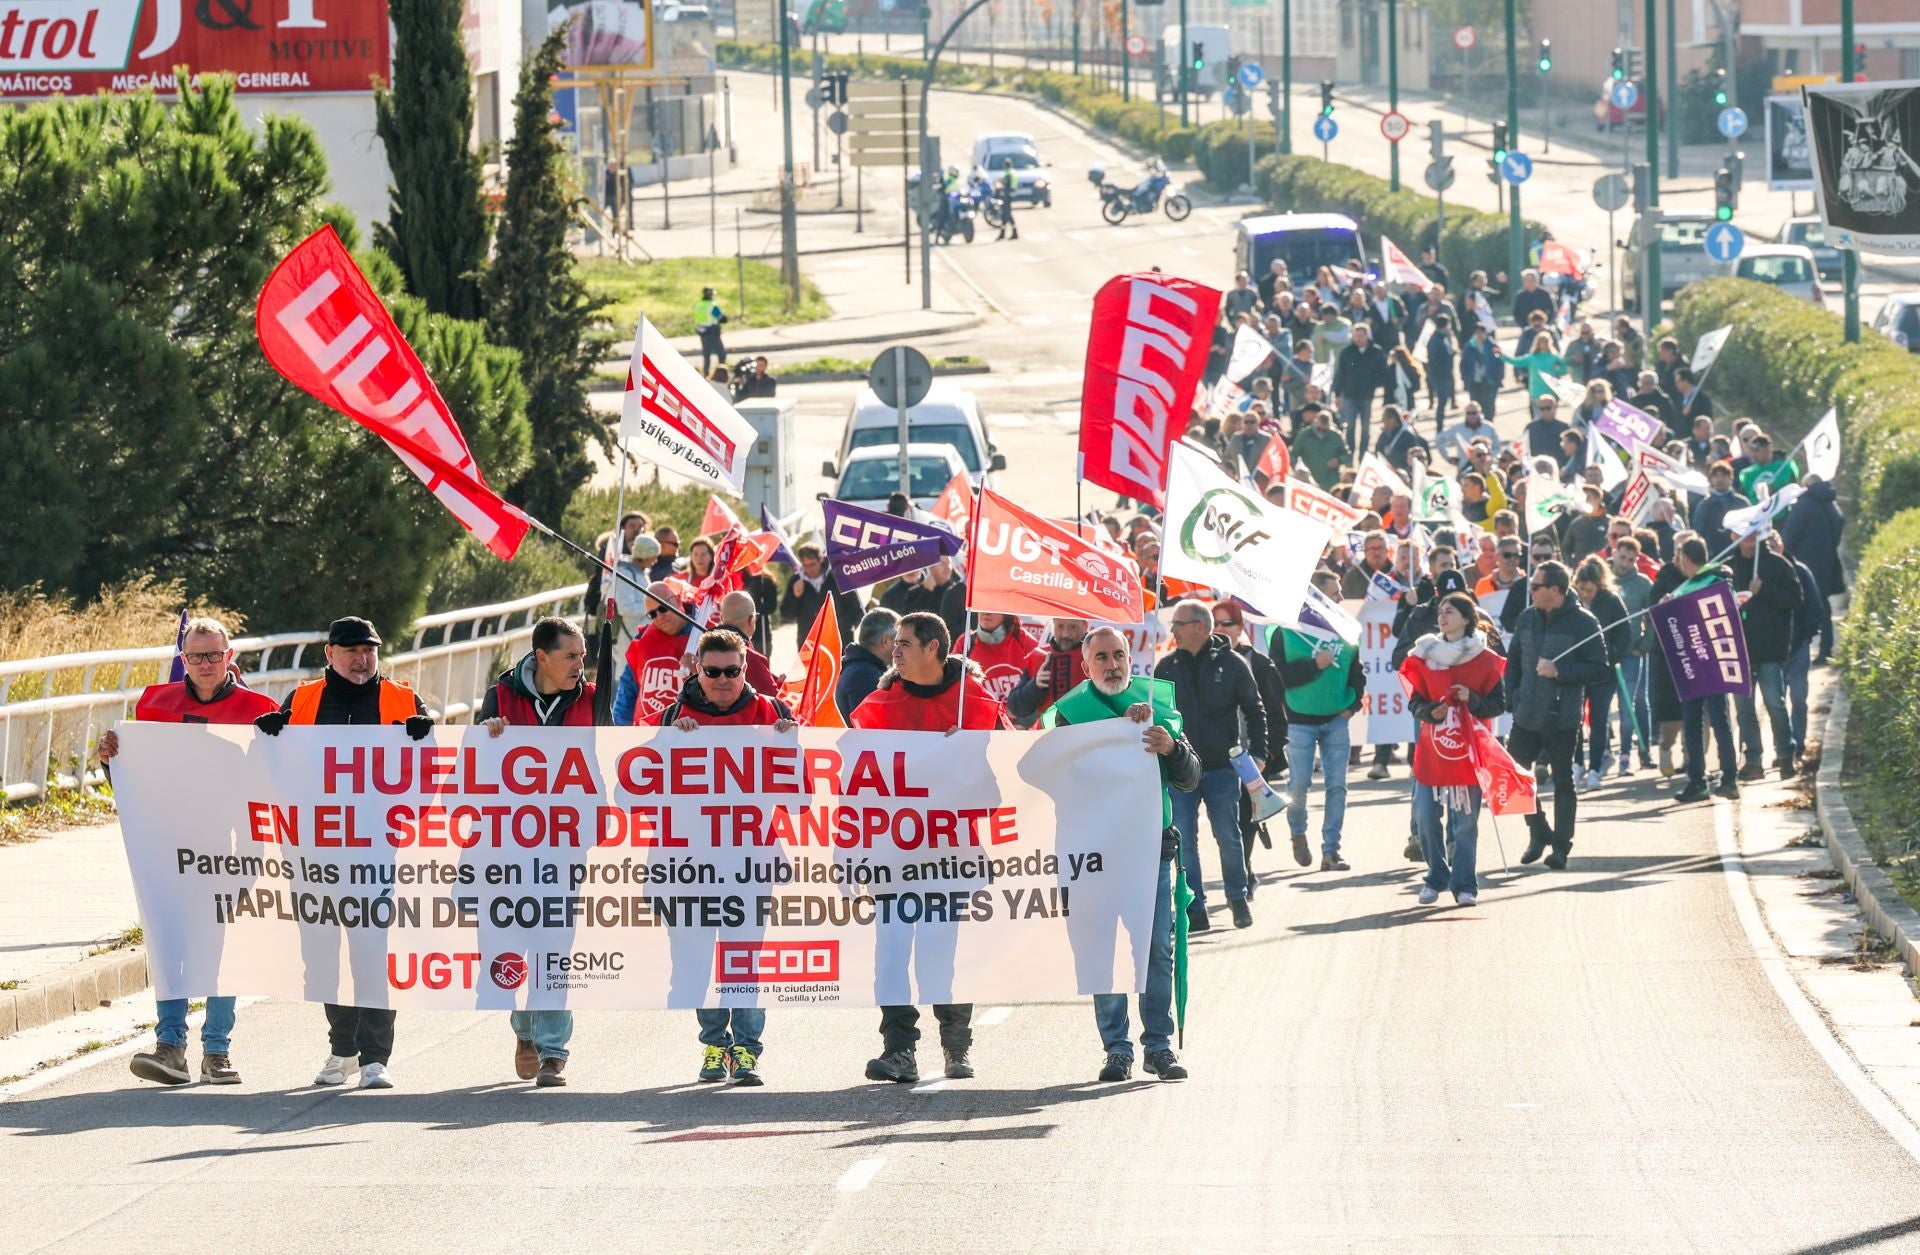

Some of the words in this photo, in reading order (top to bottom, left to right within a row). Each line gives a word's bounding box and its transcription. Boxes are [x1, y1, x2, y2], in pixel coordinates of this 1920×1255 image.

[269, 38, 374, 61] MOTIVE
[238, 72, 310, 88] GENERAL
[977, 517, 1069, 566] UGT
[843, 557, 880, 575] Castilla
[881, 555, 888, 566] y
[889, 545, 916, 561] León
[1009, 566, 1073, 590] Castilla
[1077, 580, 1088, 595] y
[1093, 582, 1131, 605] León
[1667, 617, 1685, 650] Castilla
[1681, 657, 1695, 680] León
[1688, 624, 1709, 660] mujer
[1698, 594, 1743, 683] CCOO
[643, 667, 690, 692] UGT
[325, 747, 595, 794] HUELGA
[618, 747, 928, 797] GENERAL
[248, 802, 298, 846] EN
[316, 805, 371, 846] EL
[387, 805, 579, 848] SECTOR
[597, 806, 688, 847] DEL
[702, 805, 1018, 850] TRANSPORTE
[177, 849, 294, 880] Paremos
[300, 857, 339, 884] las
[350, 864, 475, 885] muertes
[485, 864, 521, 884] en
[534, 858, 558, 885] la
[570, 857, 724, 891] profesión.
[735, 857, 892, 885] Jubilación
[902, 850, 1059, 884] anticipada
[1068, 852, 1104, 881] ya
[214, 888, 420, 928] ¡¡APLICACIÓN
[433, 897, 479, 928] DE
[490, 895, 745, 928] COEFICIENTES
[756, 891, 993, 927] REDUCTORES
[1003, 887, 1070, 919] YA!!
[388, 953, 481, 990] UGT
[546, 952, 624, 971] FeSMC
[546, 973, 583, 981] Servicios,
[724, 949, 831, 975] CCOO
[715, 984, 761, 993] servicios
[772, 984, 782, 993] la
[784, 983, 840, 993] ciudadanía
[778, 994, 810, 1003] Castilla
[819, 994, 840, 1002] León
